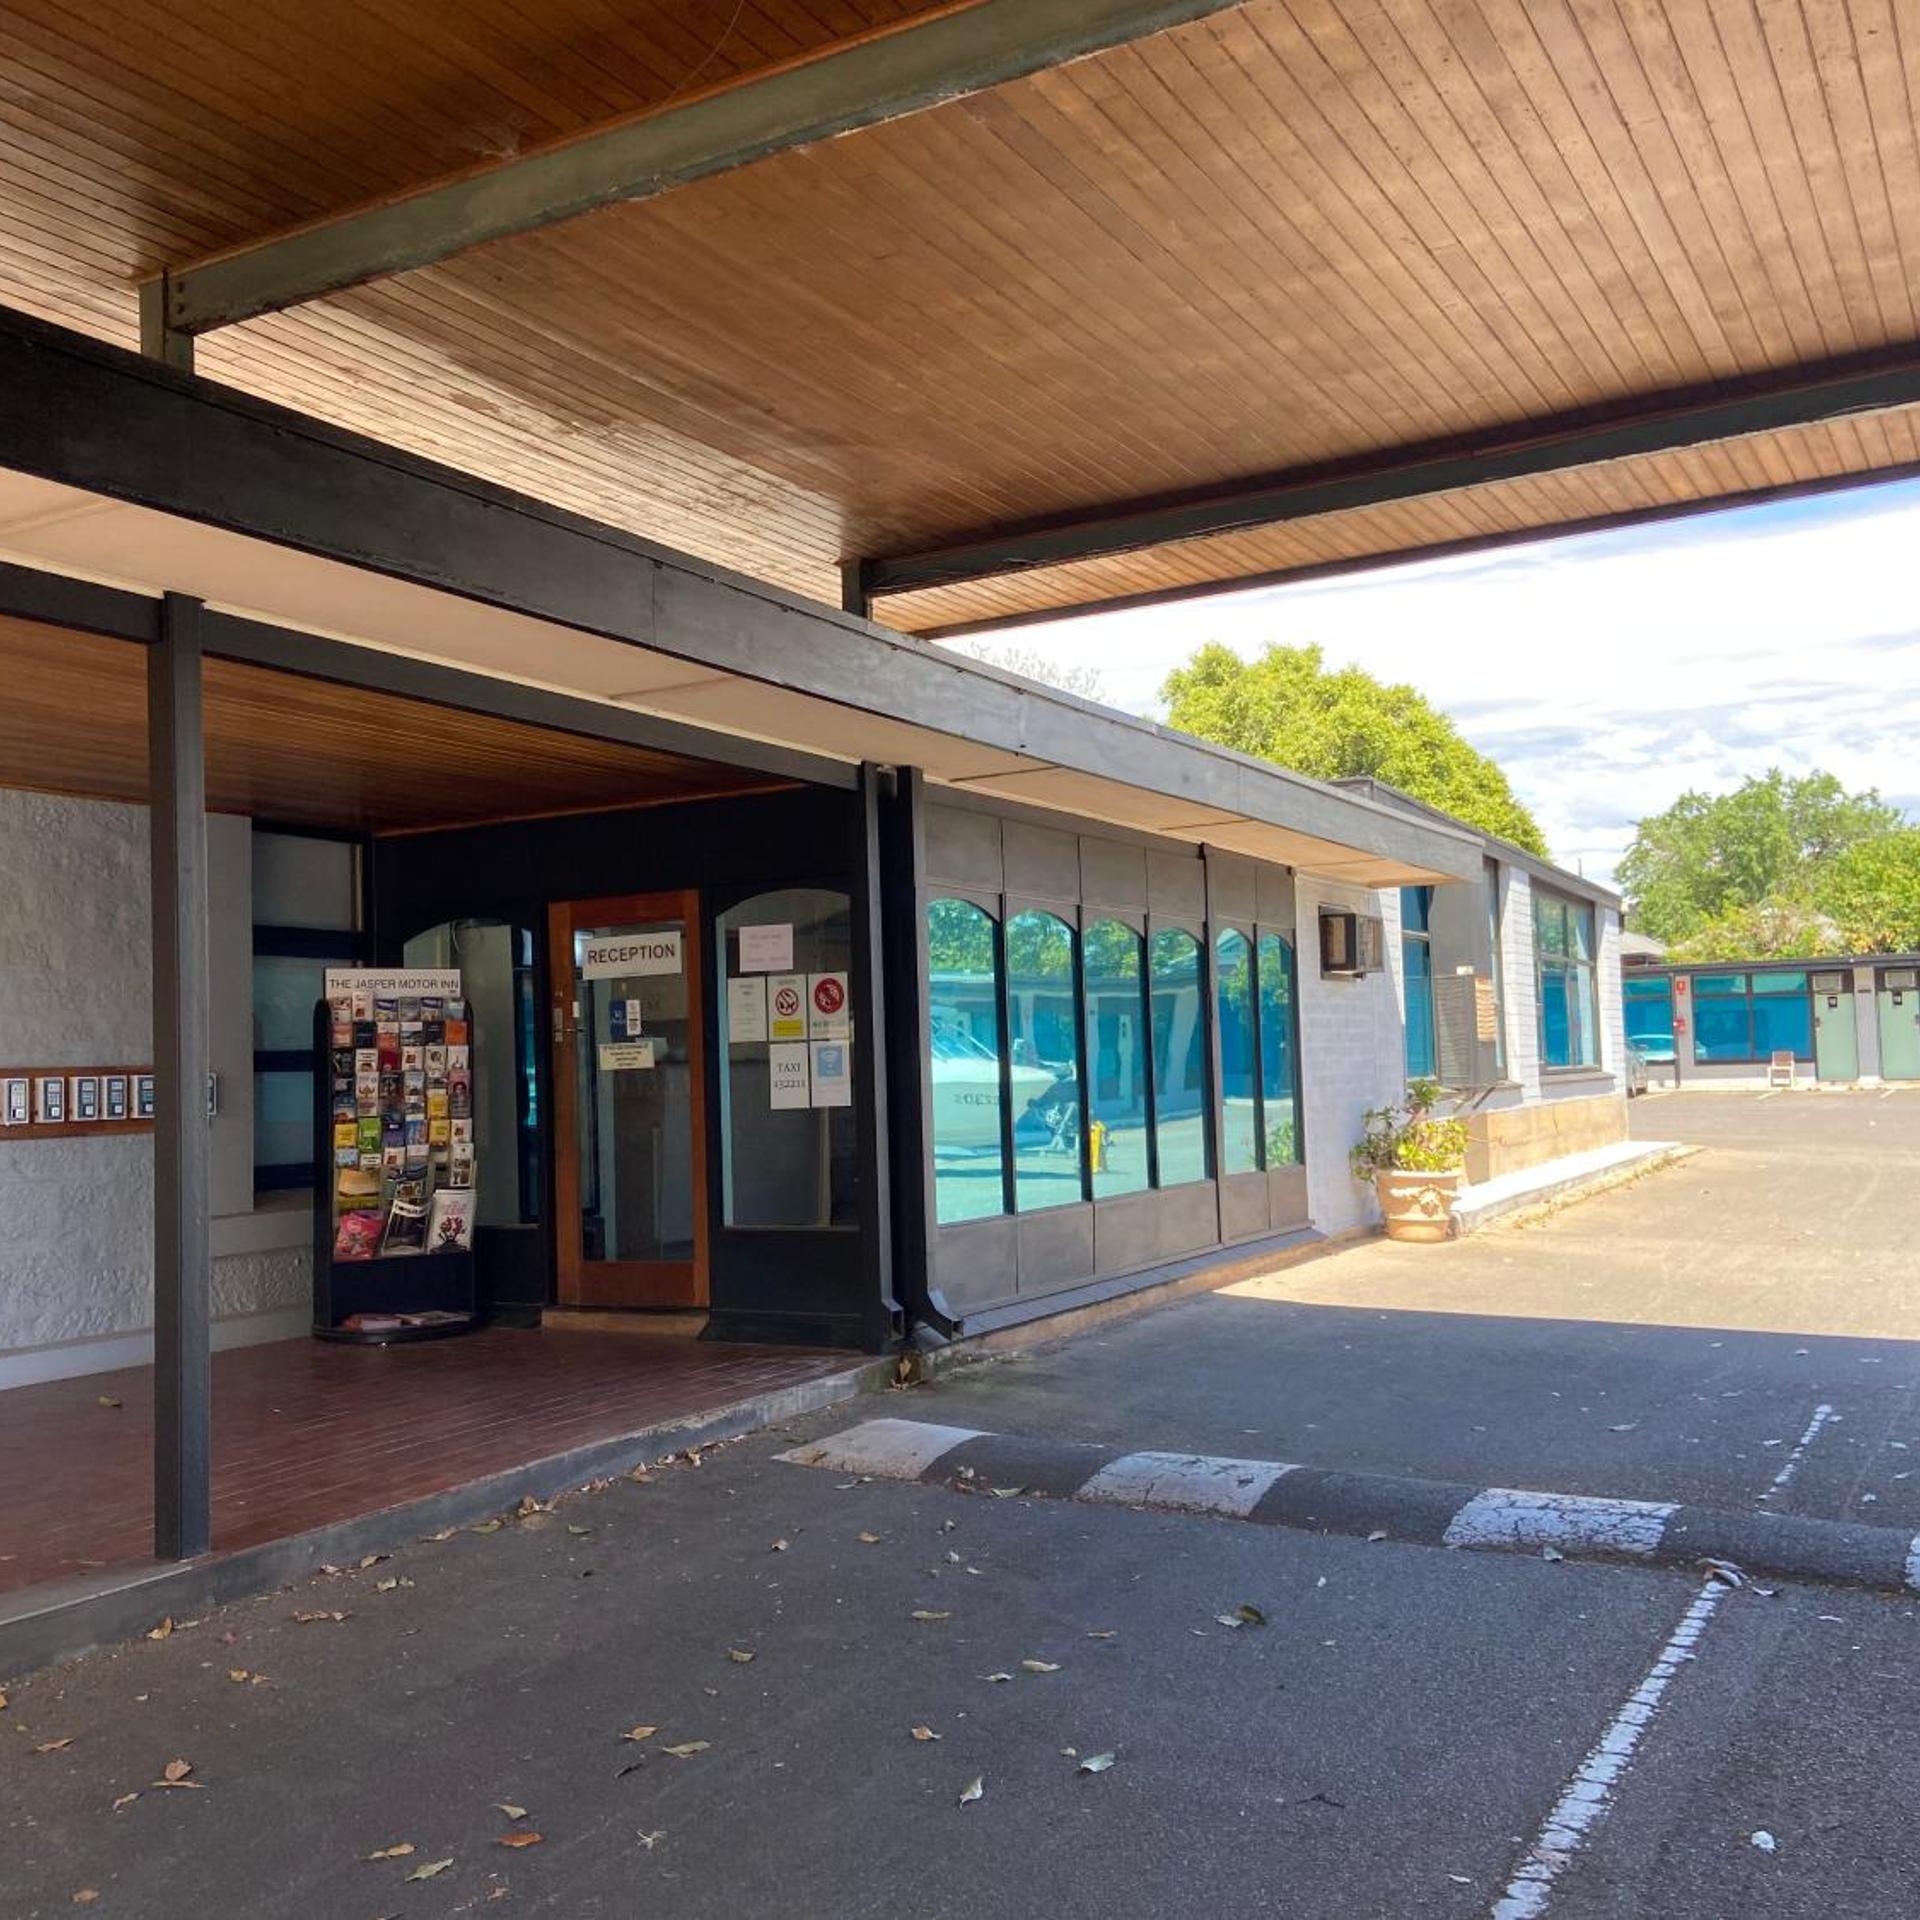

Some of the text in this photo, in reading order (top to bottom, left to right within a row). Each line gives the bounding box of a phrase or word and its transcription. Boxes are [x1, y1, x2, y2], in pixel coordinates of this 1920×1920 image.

[587, 944, 676, 965] RECEPTION
[329, 979, 459, 989] THE JASPER MOTOR INN
[776, 1062, 801, 1073] TAXI
